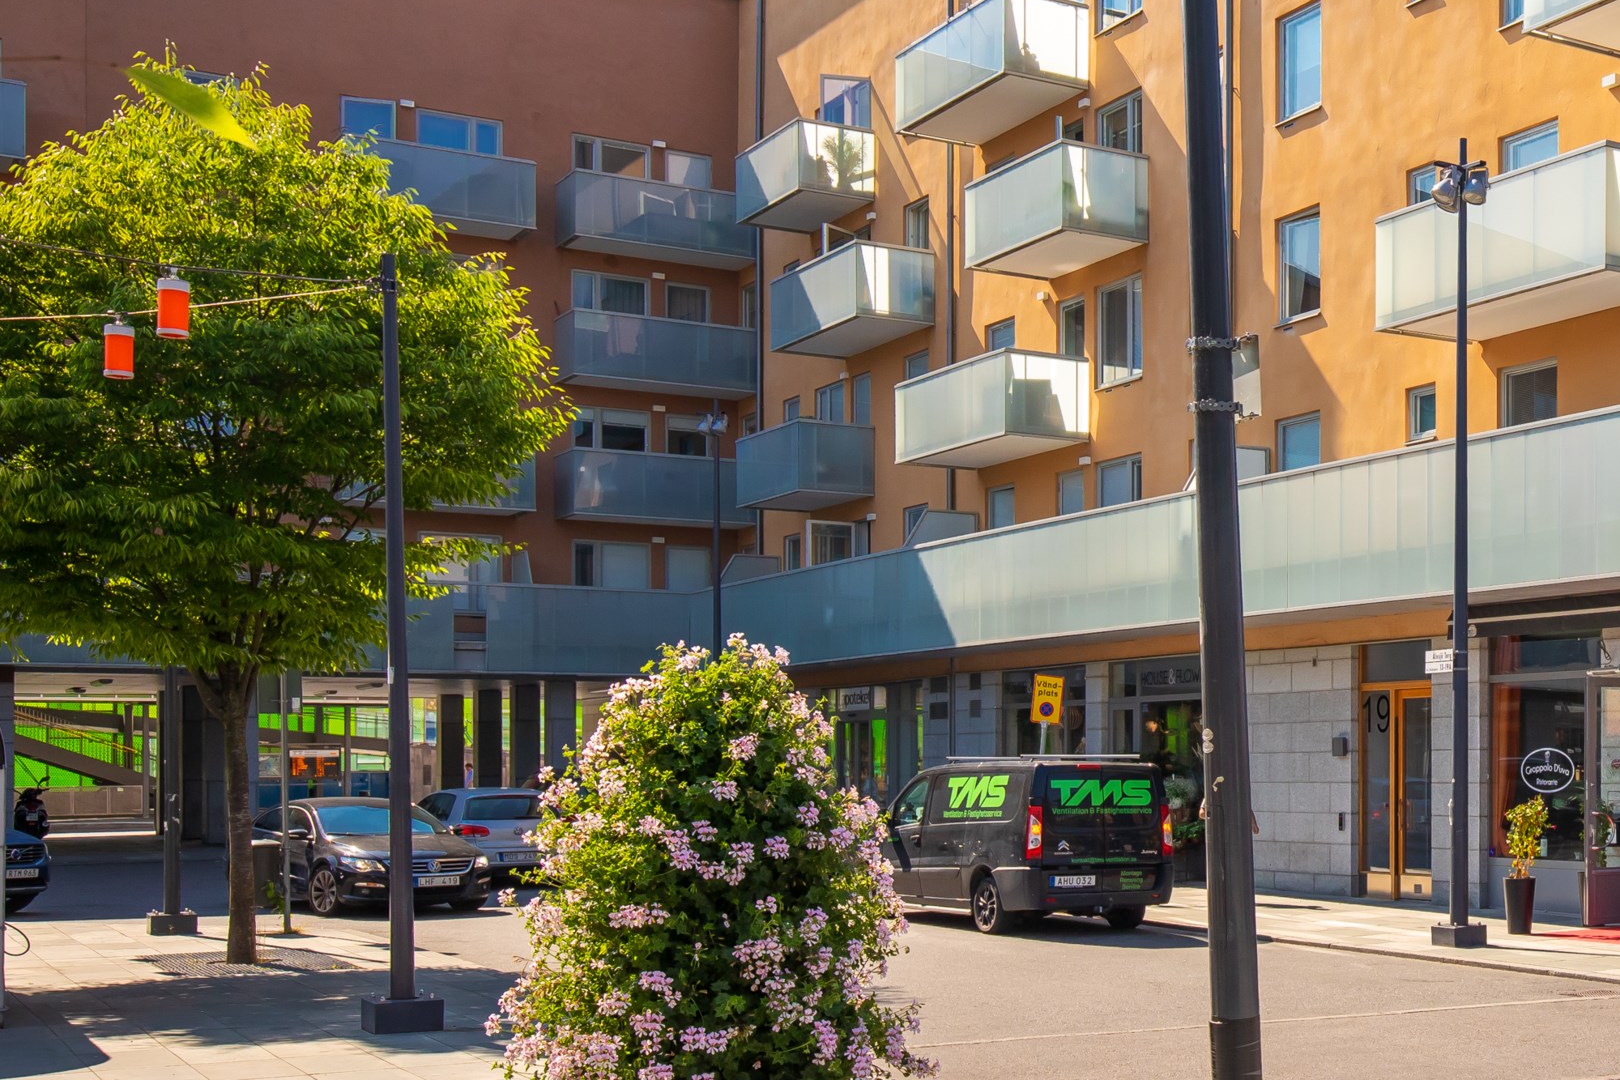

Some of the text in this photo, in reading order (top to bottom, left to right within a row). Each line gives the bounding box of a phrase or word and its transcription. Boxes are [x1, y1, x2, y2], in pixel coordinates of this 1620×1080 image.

[1037, 681, 1062, 689] Vänd-
[1038, 689, 1059, 698] plats
[1363, 695, 1390, 733] 19
[1525, 763, 1553, 775] Grappolo
[948, 775, 1009, 808] TMS
[1051, 780, 1151, 806] TMS
[1052, 807, 1088, 815] Ventilation
[420, 877, 458, 886] LHF 419
[1057, 876, 1092, 885] AHU 032
